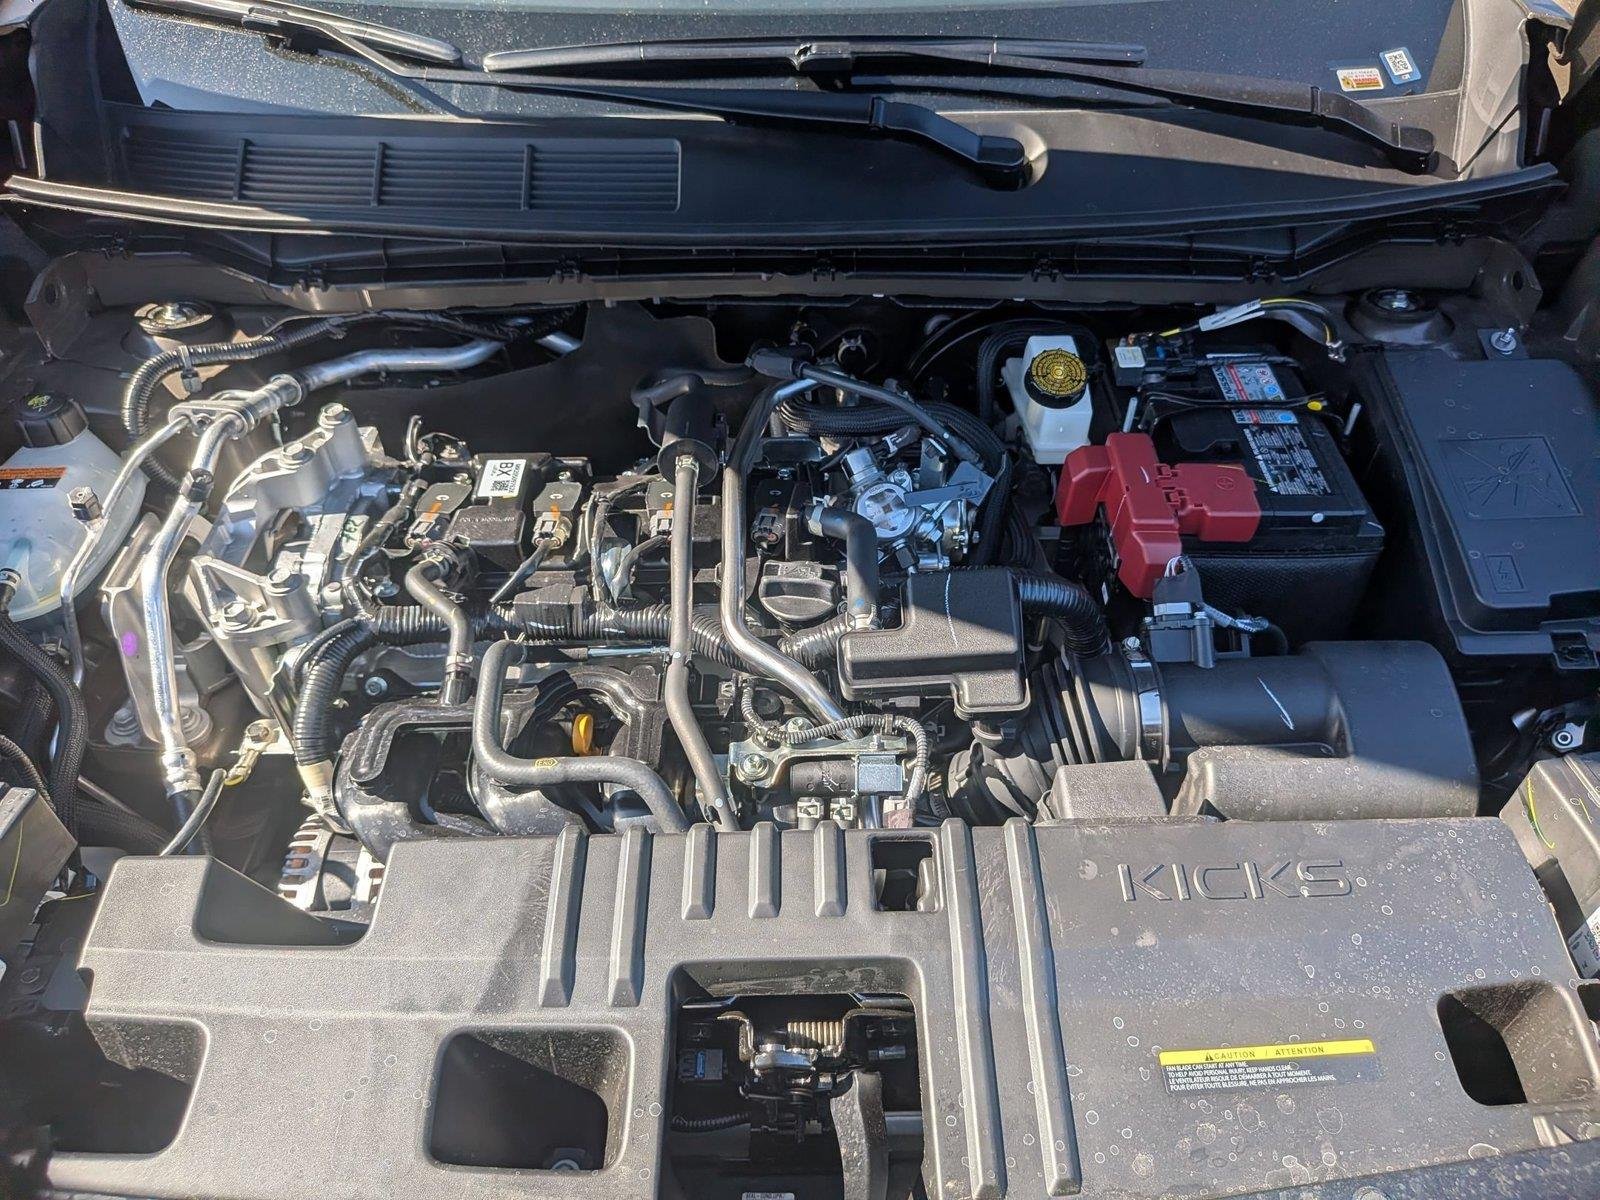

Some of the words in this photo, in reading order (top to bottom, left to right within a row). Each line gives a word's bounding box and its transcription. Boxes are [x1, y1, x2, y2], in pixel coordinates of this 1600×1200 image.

[498, 461, 514, 477] BX
[1117, 859, 1352, 902] KICKS
[1214, 1050, 1256, 1060] CAUTION
[1275, 1045, 1325, 1056] ATTENTION
[1175, 1076, 1210, 1085] VENTILATEUR
[1210, 1075, 1230, 1083] RISQUE
[1277, 1075, 1308, 1085] APPROCHER
